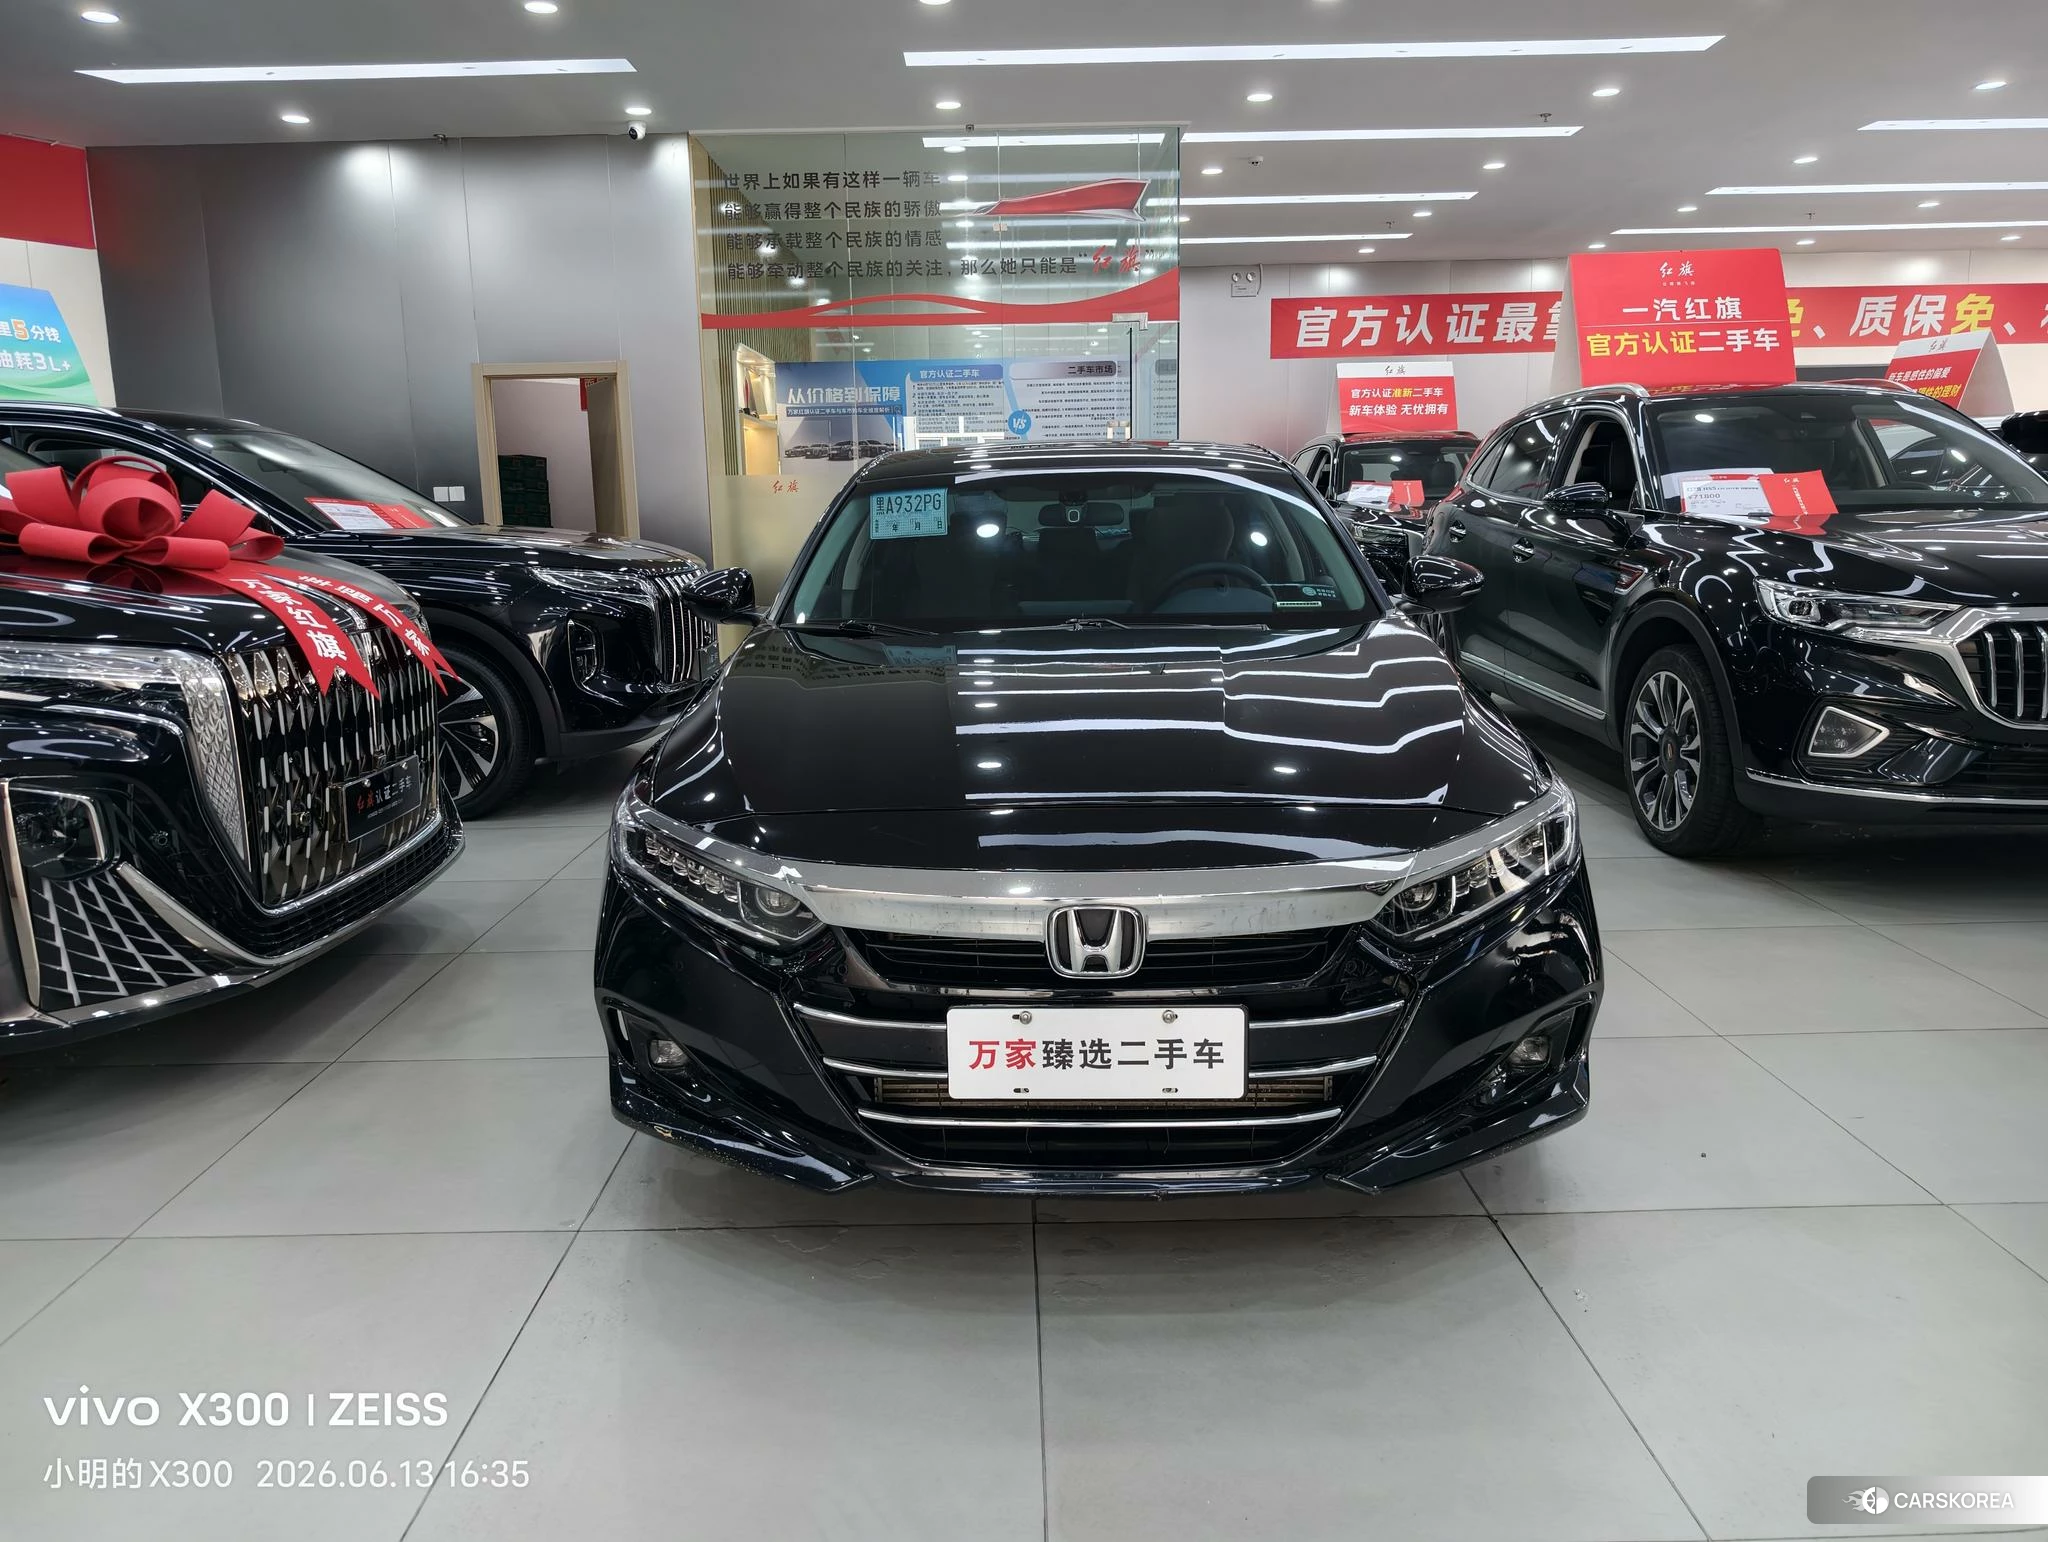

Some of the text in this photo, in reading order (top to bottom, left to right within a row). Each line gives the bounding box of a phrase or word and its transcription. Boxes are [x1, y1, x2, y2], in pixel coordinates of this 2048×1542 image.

[724, 170, 941, 191] 世界上如果有这样一辆车
[725, 200, 942, 221] 能够赢得整个民族的骄傲
[727, 230, 943, 250] 能够承载整个民族的情感
[1622, 296, 1742, 321] 一汽红旗
[1787, 293, 2048, 339] 、质保免、
[1586, 327, 1780, 357] 官方认证二手车
[919, 369, 981, 379] 官方认证二手车
[1067, 364, 1113, 375] 二手车市场
[787, 386, 901, 404] 从价格到保障
[1351, 387, 1444, 399] 官方认证准新二手车
[1349, 403, 1448, 416] 新车体验 无忧拥有
[876, 493, 942, 515] 黑A932PG
[968, 1038, 1225, 1070] 万家臻选二手车
